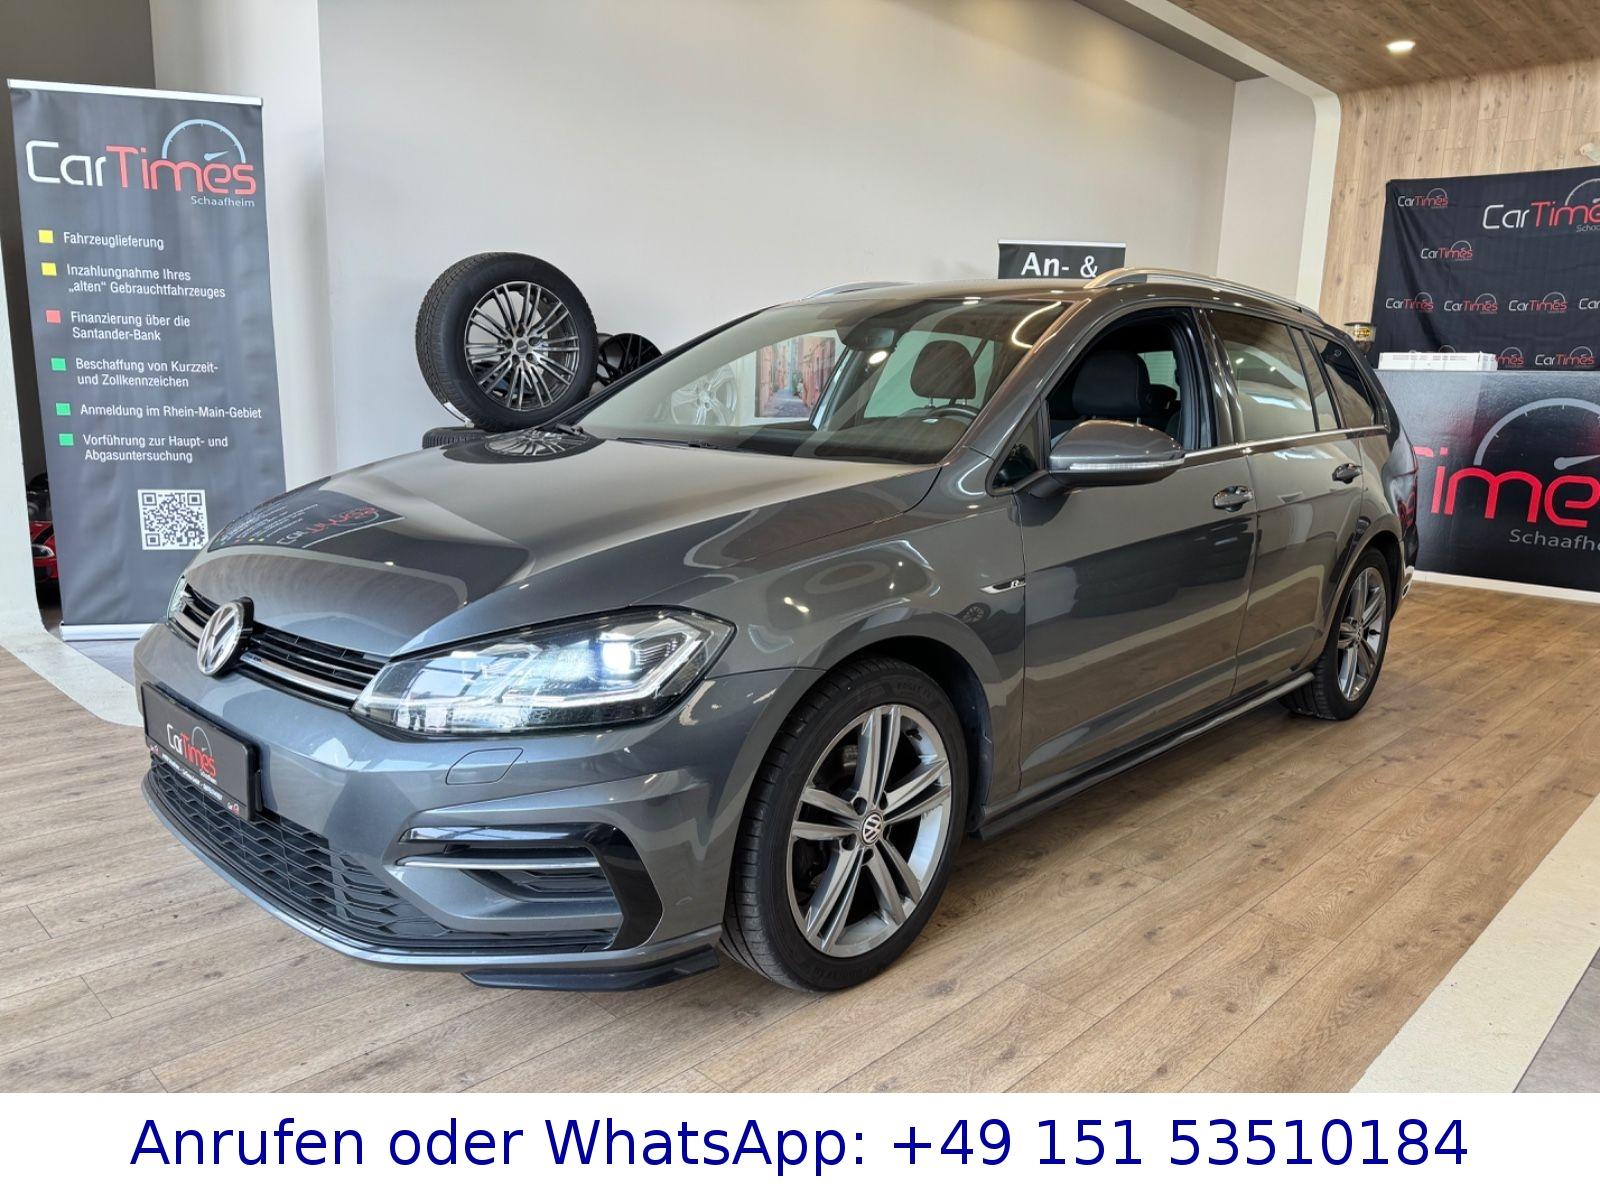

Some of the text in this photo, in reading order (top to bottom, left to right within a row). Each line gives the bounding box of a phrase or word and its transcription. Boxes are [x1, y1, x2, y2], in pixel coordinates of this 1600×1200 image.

[26, 140, 257, 196] CarTimes
[190, 196, 255, 208] Schaafheim
[1397, 195, 1449, 207] CarTimes
[1482, 201, 1600, 230] CarTime
[63, 231, 164, 251] Fahrzeuglieferung
[1420, 247, 1473, 259] CarTimes
[66, 263, 191, 281] Inzahlungnahme Ihres
[1020, 251, 1098, 279] An- &
[110, 281, 226, 299] Gebrauchtfahrzeuges
[1443, 300, 1498, 312] CarTimes
[1508, 299, 1568, 312] CarTimes
[70, 311, 191, 327] Finanzierung über die
[72, 327, 162, 342] Santander-Bank
[75, 357, 219, 373] Beschaffung von Kurzzeit-
[1534, 353, 1596, 366] CarTimes
[77, 374, 189, 388] und Zollkennzeichen
[80, 404, 262, 419] Anmeldung im Rhein-Main-Gebiet
[83, 434, 228, 449] Vorführung zur Haupt- und
[84, 450, 193, 464] Abgasuntersuchung
